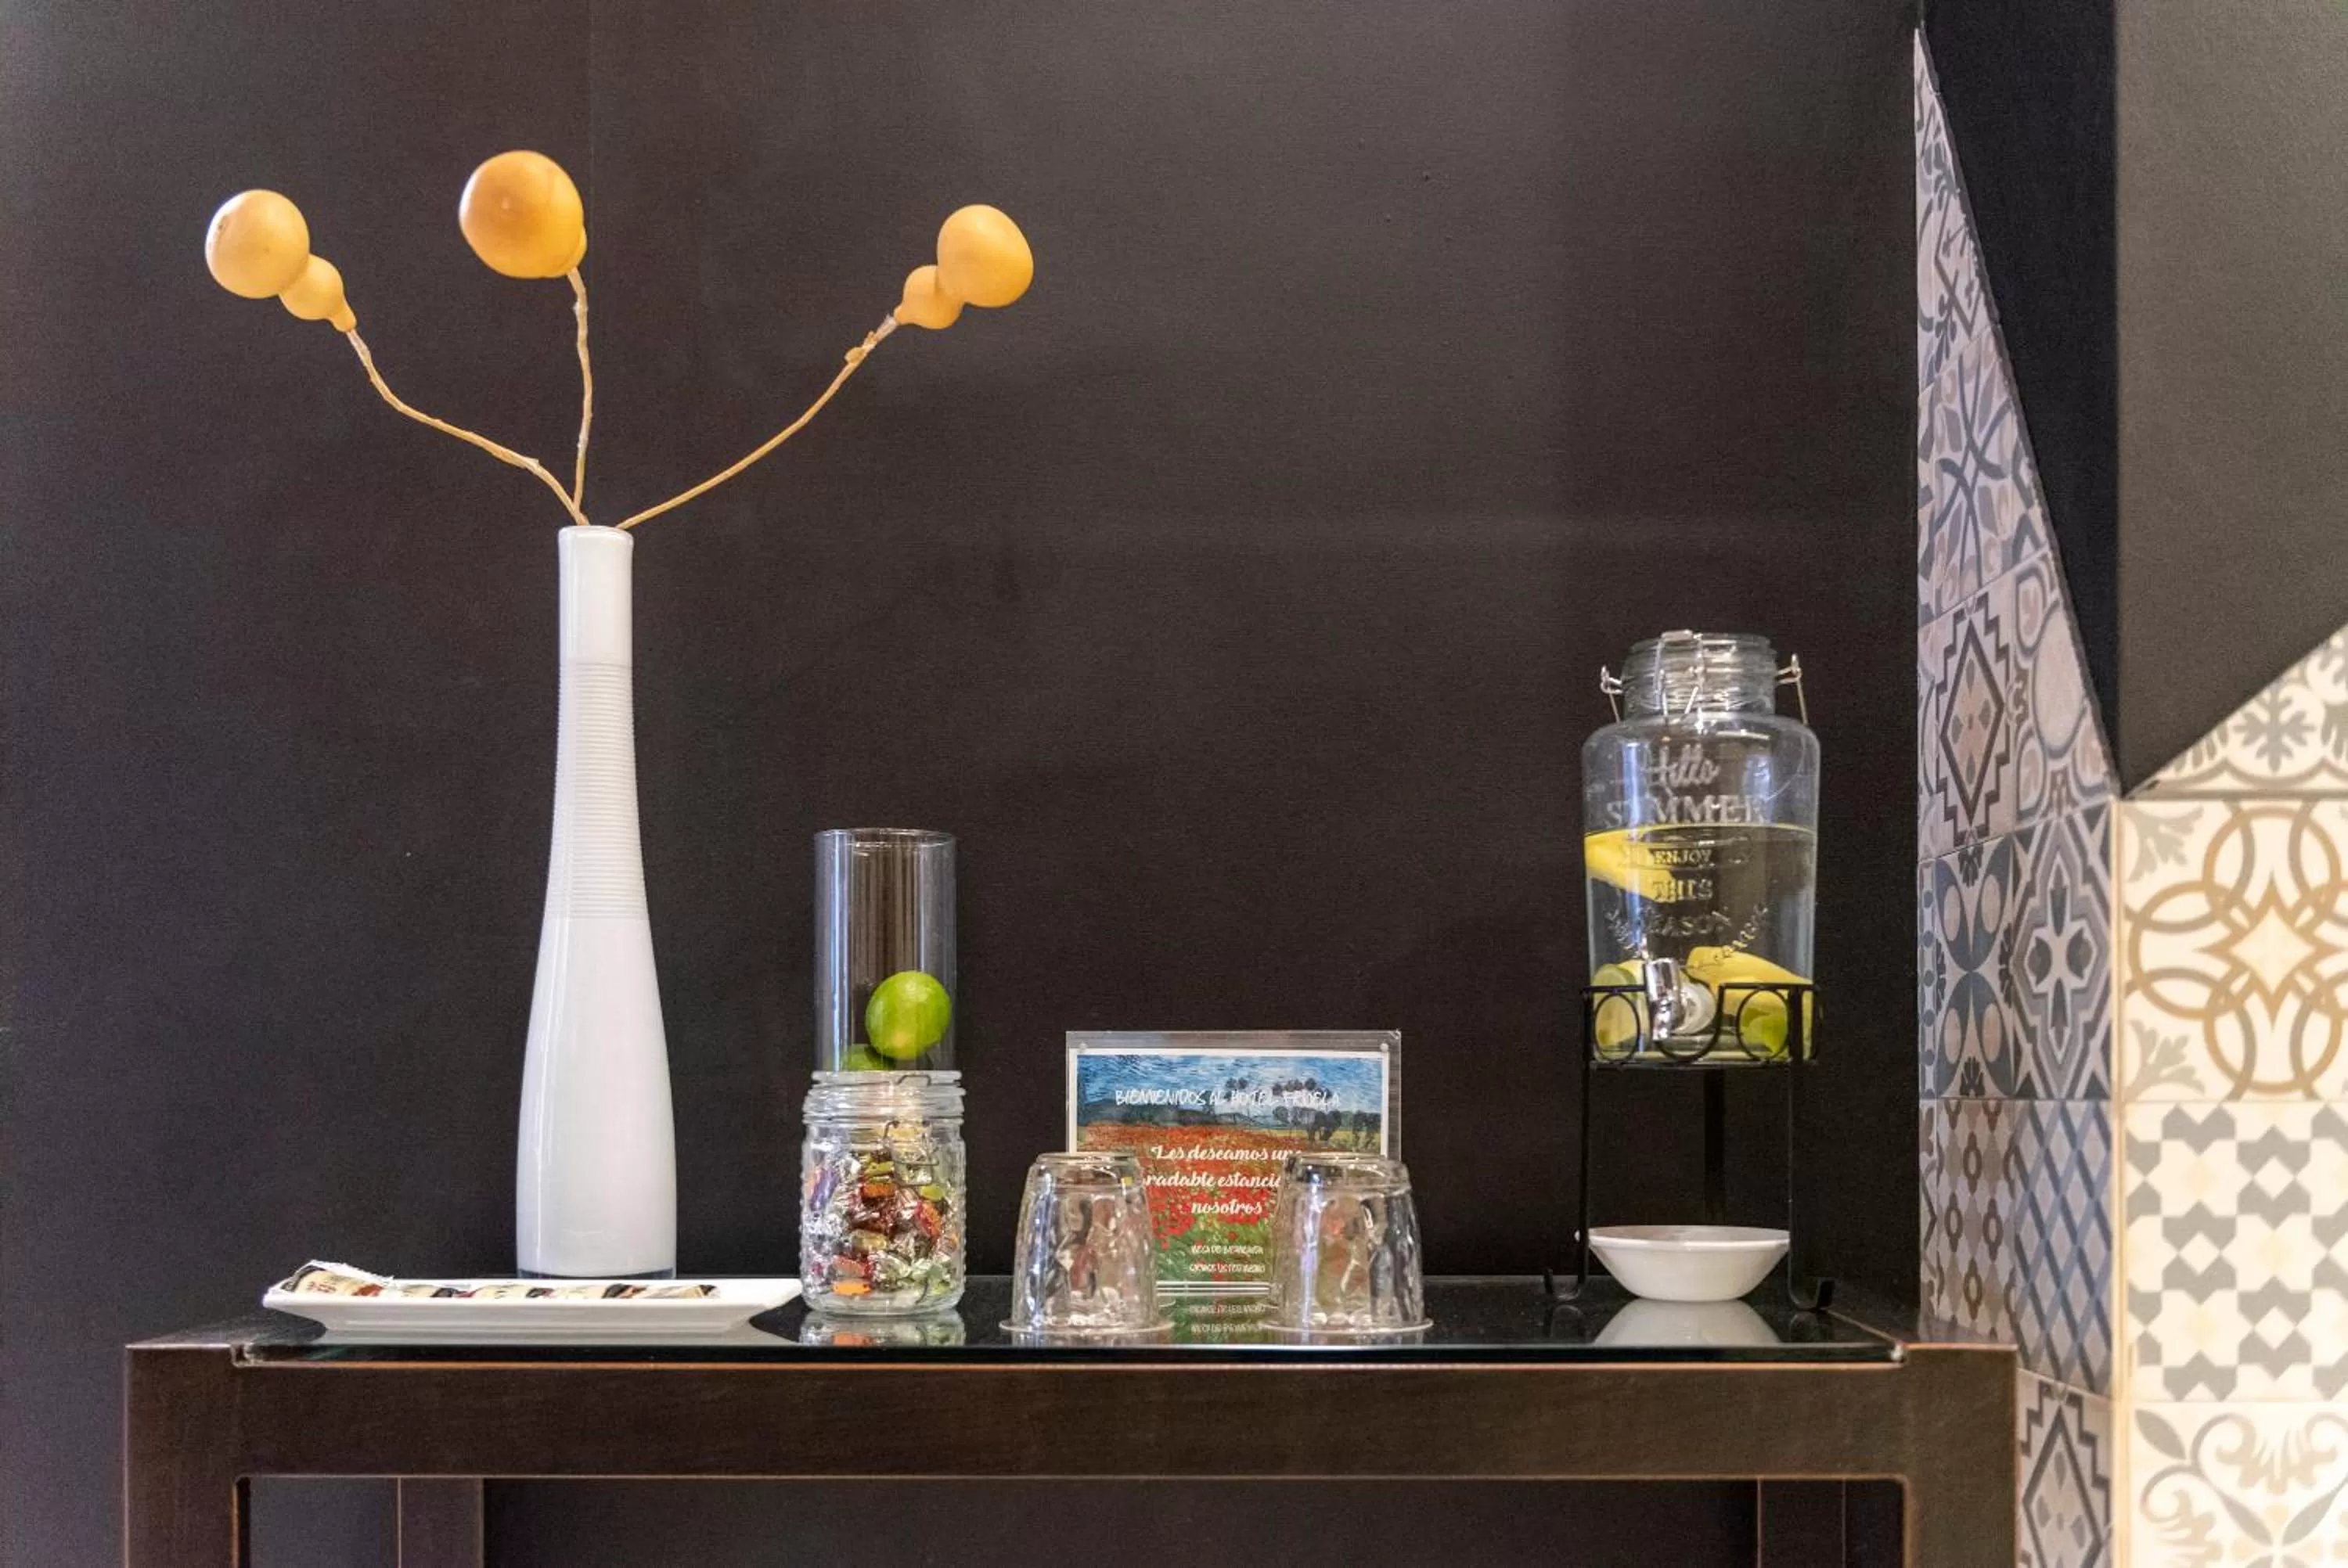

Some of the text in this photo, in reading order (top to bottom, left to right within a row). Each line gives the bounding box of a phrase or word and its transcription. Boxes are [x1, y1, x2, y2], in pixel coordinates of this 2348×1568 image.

[1640, 744, 1720, 787] Hello
[1604, 794, 1769, 828] SMMER
[1652, 849, 1712, 865] ENJOY
[1651, 879, 1714, 901] THIS
[1115, 1088, 1207, 1106] BIENVENIDOS
[1209, 1088, 1226, 1106] AL
[1230, 1088, 1279, 1106] HOTEL
[1151, 1145, 1302, 1161] Les deseamos un
[1144, 1171, 1215, 1188] radable
[1191, 1199, 1262, 1214] nosotros
